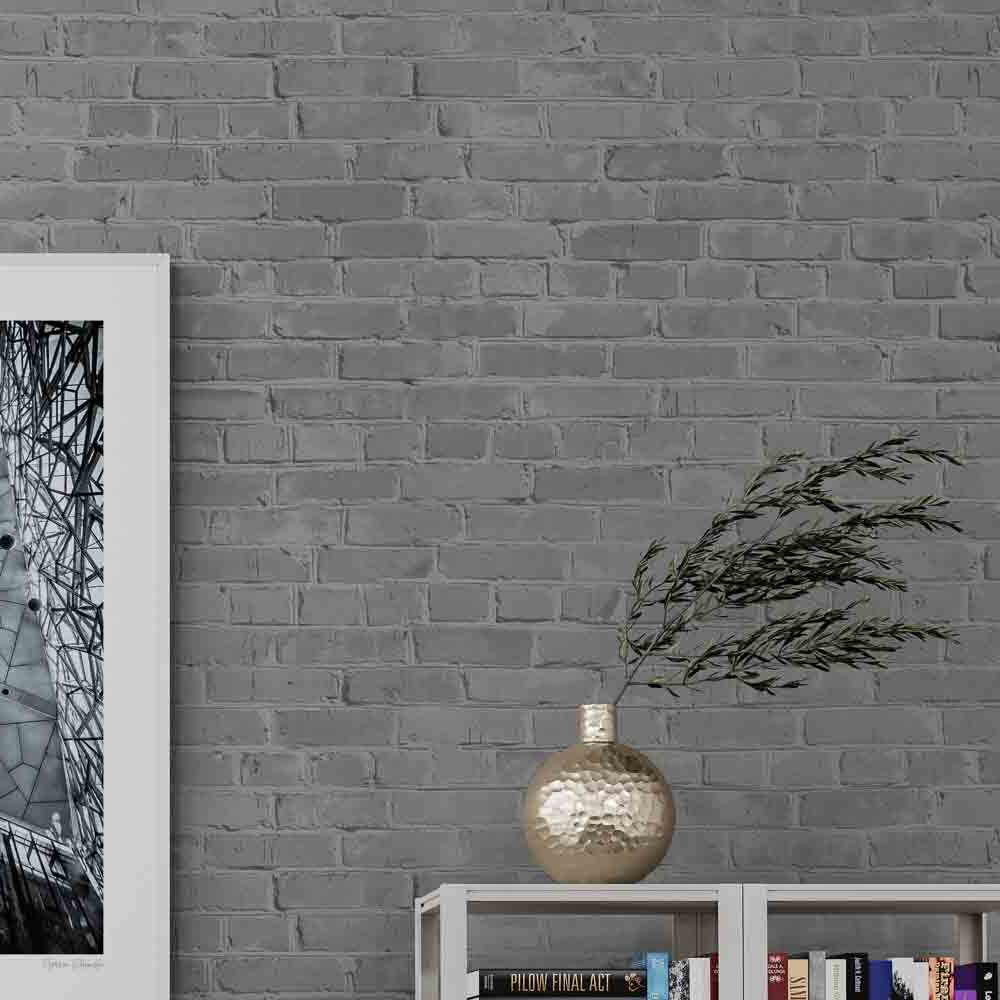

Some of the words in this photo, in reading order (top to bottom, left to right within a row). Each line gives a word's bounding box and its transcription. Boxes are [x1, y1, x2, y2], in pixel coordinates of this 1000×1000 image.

[511, 973, 548, 992] PILOW
[552, 973, 585, 992] FINAL
[589, 973, 611, 992] ACT
